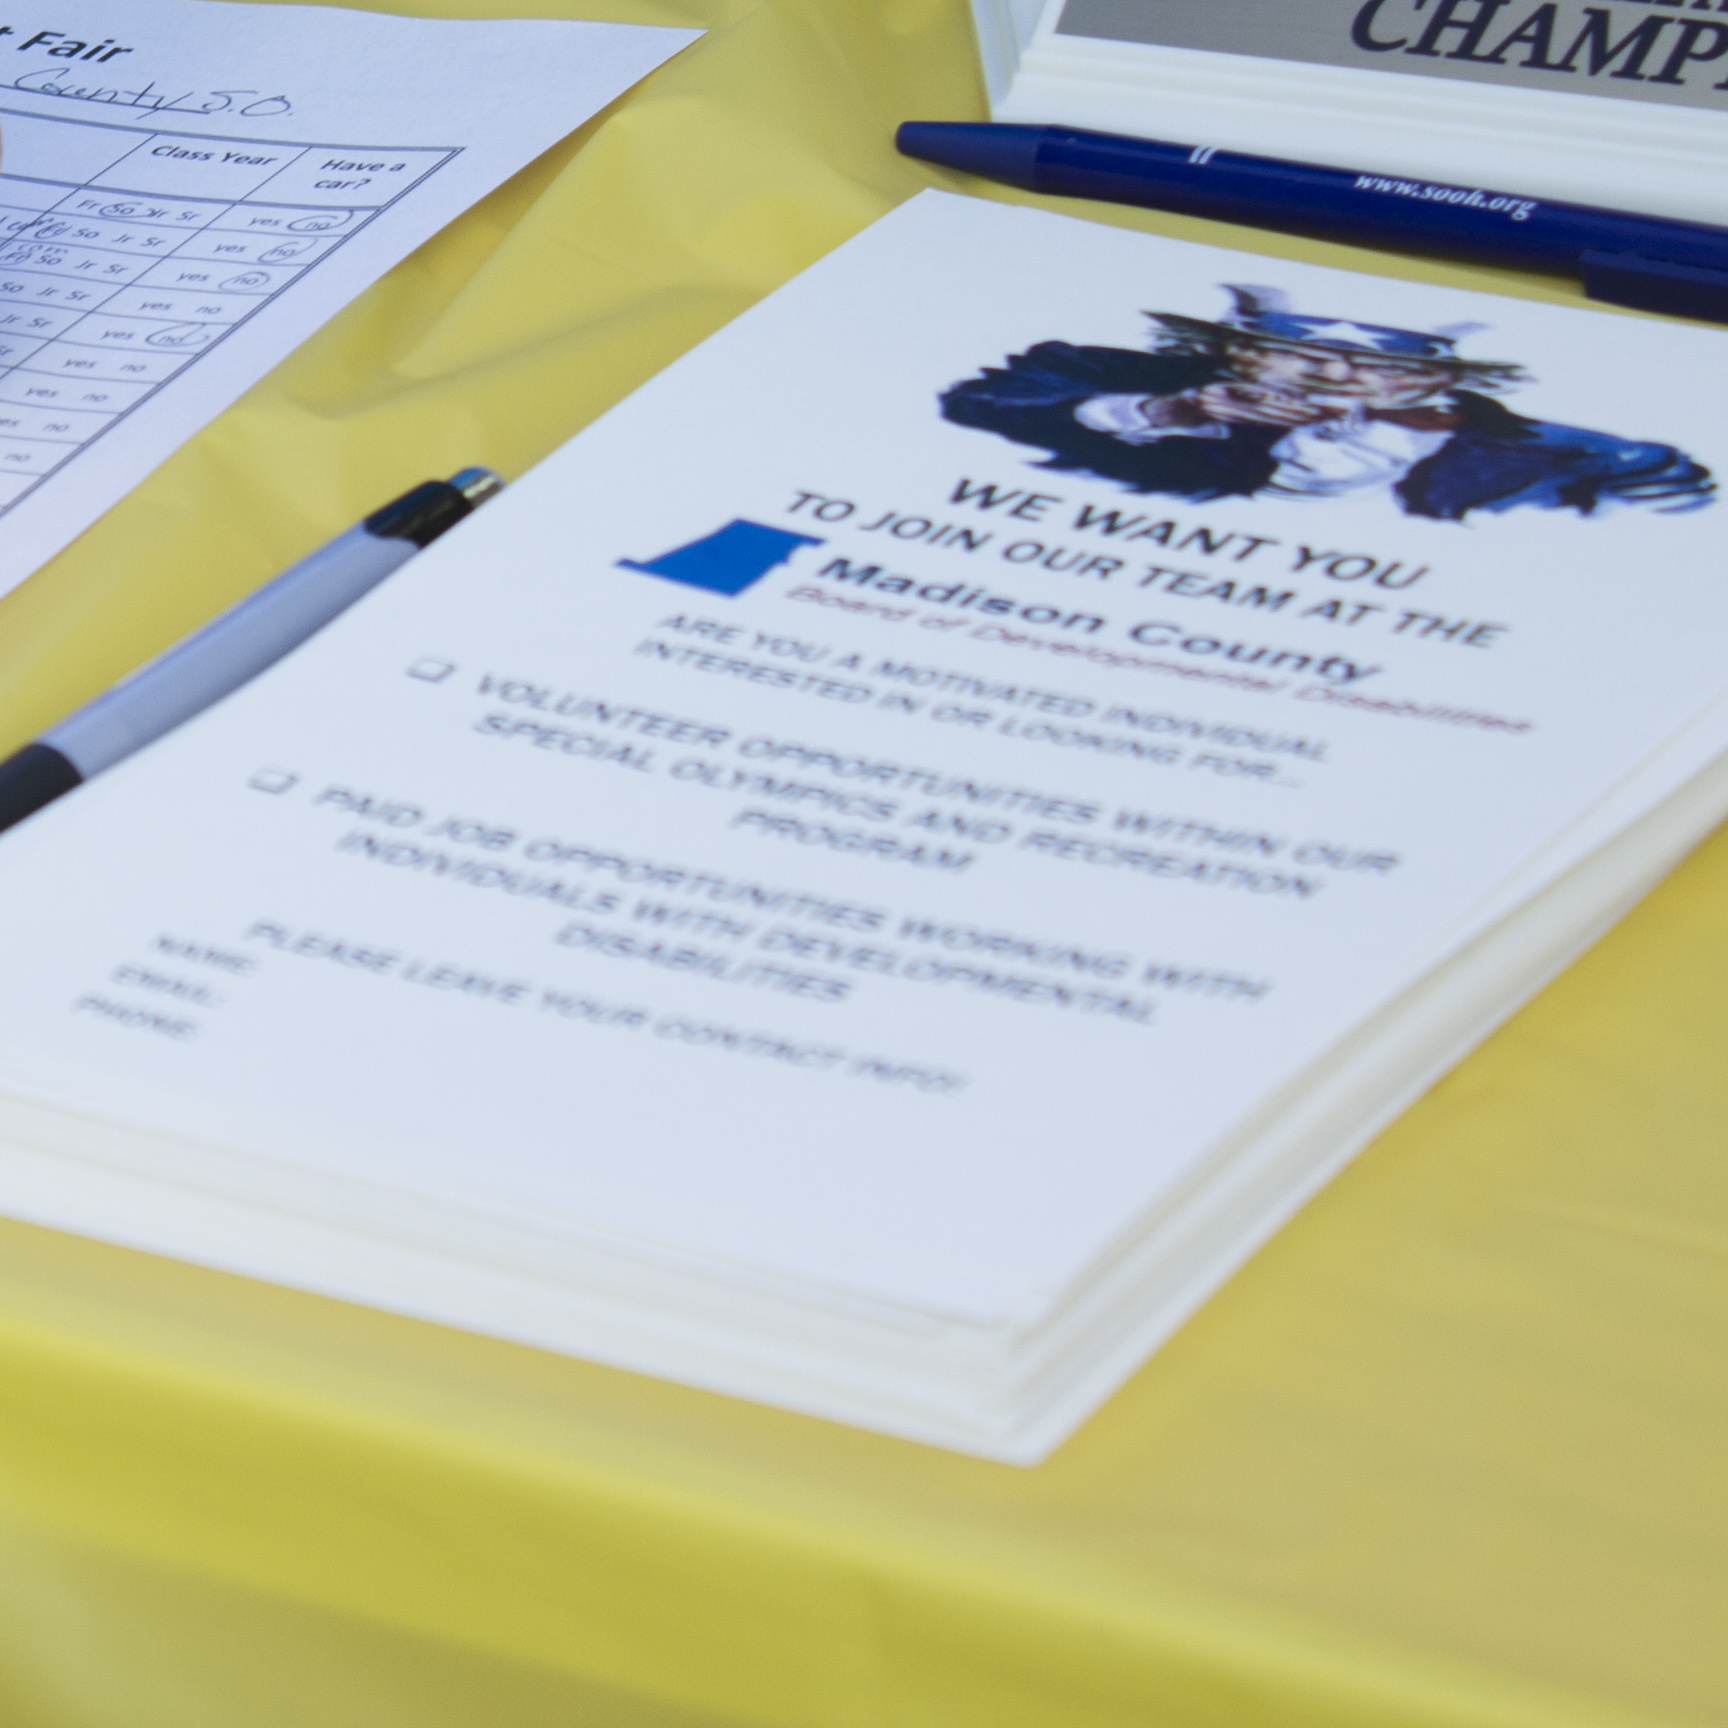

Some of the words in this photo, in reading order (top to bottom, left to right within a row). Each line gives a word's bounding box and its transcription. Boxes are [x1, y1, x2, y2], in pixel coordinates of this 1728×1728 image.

[17, 31, 134, 63] Fair
[14, 67, 193, 119] County
[151, 145, 214, 160] Class
[221, 152, 277, 165] Year
[320, 159, 384, 171] Have
[388, 163, 405, 171] a
[314, 178, 371, 189] car?
[1352, 171, 1540, 222] www.sooh.org
[43, 221, 67, 236] Fr
[70, 227, 100, 239] So
[111, 232, 135, 244] Jr
[139, 236, 166, 247] Sr
[212, 243, 248, 254] yes
[268, 245, 298, 258] no
[75, 198, 101, 210] Fr
[106, 202, 134, 216] So
[147, 208, 169, 218] Jr
[175, 210, 201, 221] Sr
[247, 216, 282, 227] yes
[304, 217, 331, 231] no
[3, 251, 28, 263] Fr
[33, 251, 63, 266] So
[73, 259, 97, 270] Jr
[102, 263, 128, 275] Sr
[175, 271, 210, 282] yes
[232, 274, 261, 287] no
[35, 285, 60, 297] Jr
[64, 289, 90, 301] Sr
[137, 301, 173, 311] yes
[194, 304, 222, 315] no
[25, 316, 53, 328] Sr
[99, 329, 135, 340] yes
[157, 333, 186, 346] no
[949, 478, 1060, 521] WE
[1073, 504, 1277, 561] WANT
[1292, 545, 1428, 589] YOU
[788, 490, 856, 522] TO
[861, 512, 992, 552] JOIN
[1001, 540, 1125, 580] OUR
[1140, 566, 1296, 611] TEAM
[1305, 599, 1379, 624] AT
[1393, 610, 1505, 647] THE
[818, 557, 1105, 633] Madison
[1128, 622, 1380, 685] County
[635, 639, 874, 702] INTERESTED
[878, 693, 921, 713] IN
[931, 705, 993, 727] OR
[998, 718, 1181, 765] LOOKING
[659, 613, 743, 644] ARE
[751, 631, 830, 662] YOU
[836, 652, 863, 671] A
[872, 657, 1096, 717] MOTIVATED
[1101, 705, 1326, 762] INDIVIDUAL
[477, 674, 732, 748] VOLUNTEER
[737, 737, 1101, 823] OPPORTUNITIES
[1112, 808, 1284, 857] WITHIN
[1292, 842, 1400, 875] OUR
[474, 713, 653, 772] SPECIAL
[669, 759, 900, 821] OLYMPICS
[909, 807, 1013, 843] AND
[1022, 830, 1322, 899] RECREATION
[734, 808, 975, 871] PROGRAM
